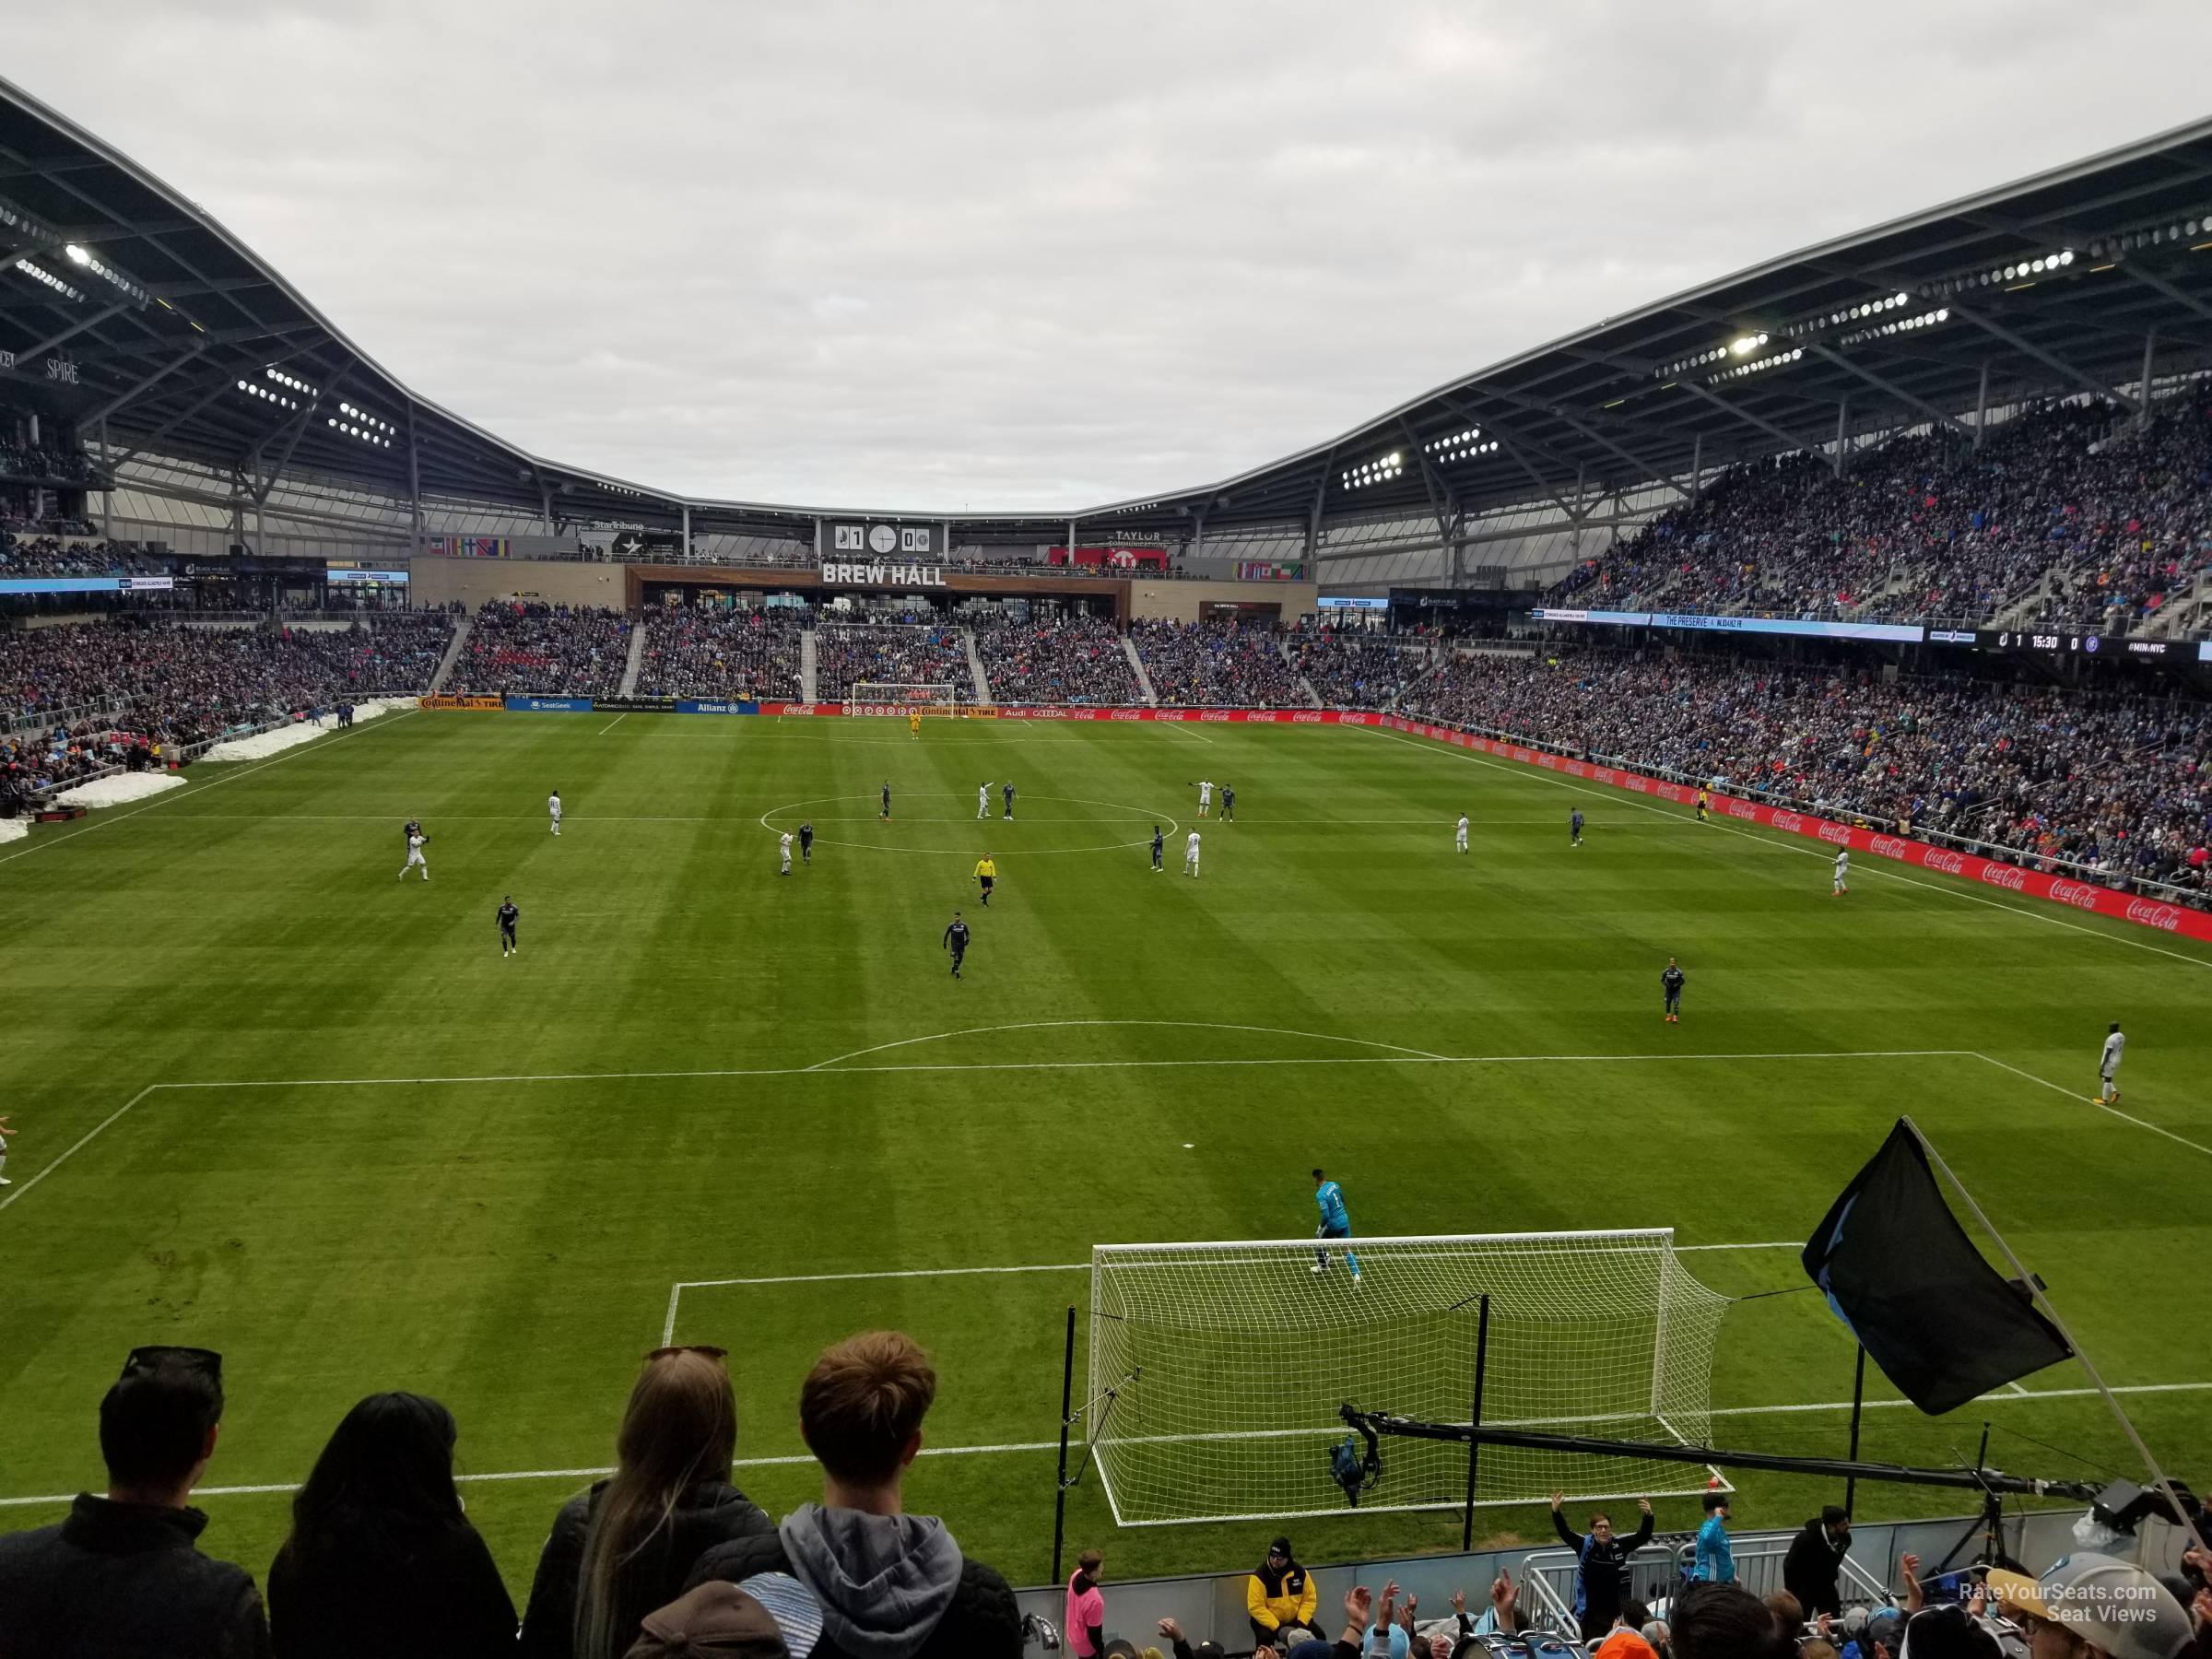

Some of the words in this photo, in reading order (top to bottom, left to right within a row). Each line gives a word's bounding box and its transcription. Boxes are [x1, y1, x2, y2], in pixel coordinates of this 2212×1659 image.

[47, 358, 79, 384] SPIRE
[594, 521, 644, 530] StarTribune
[853, 530, 860, 546] 1
[905, 532, 913, 547] 0
[1116, 531, 1160, 541] TAYLOR
[823, 564, 885, 583] BREW
[891, 564, 947, 585] HALL
[1678, 616, 1708, 627] PRESERVE
[2032, 635, 2058, 648] 15:30
[698, 703, 726, 712] Allianz
